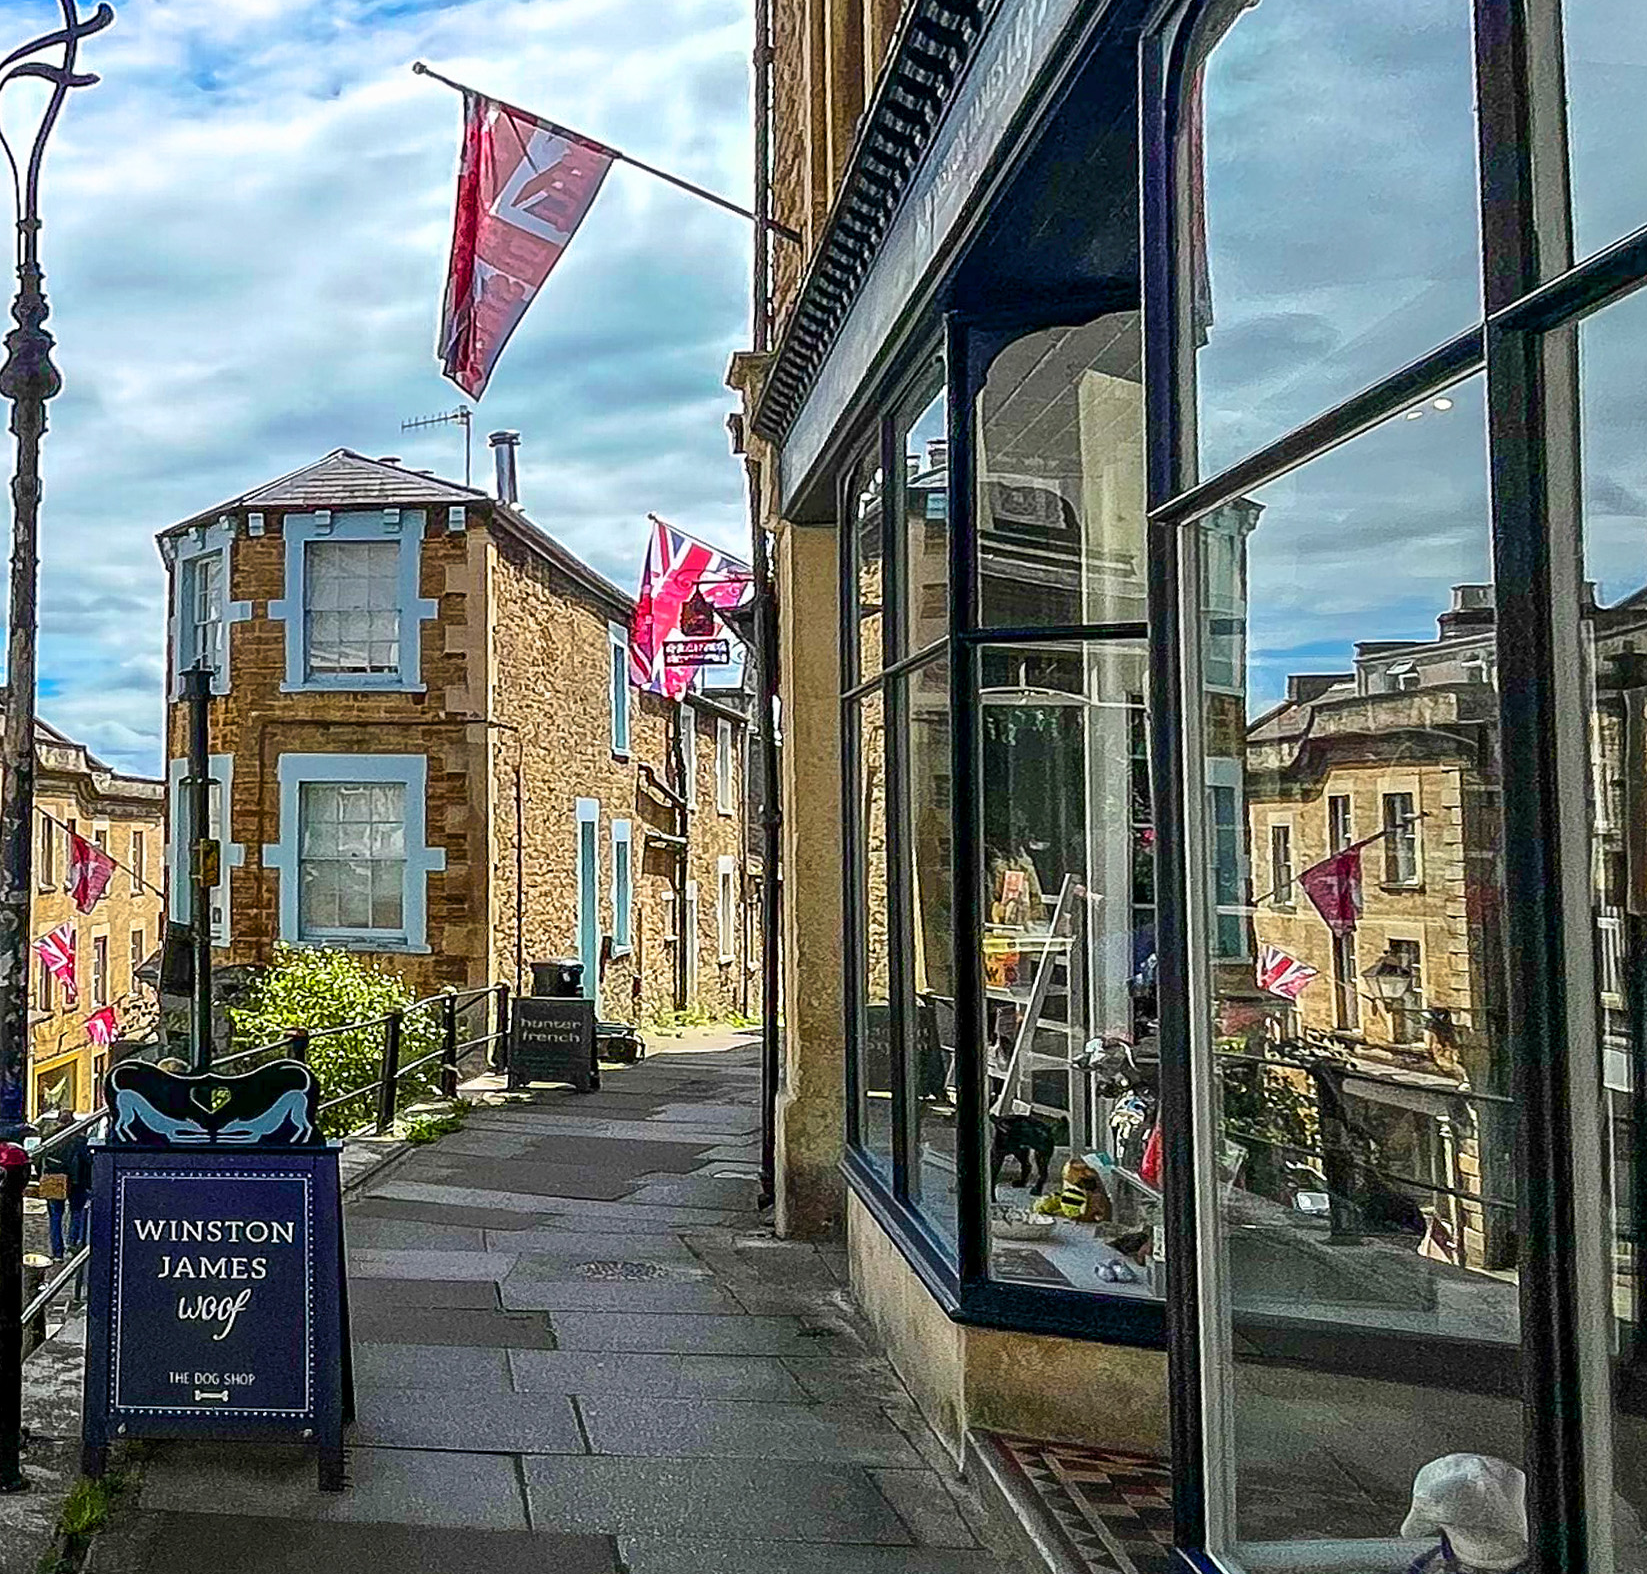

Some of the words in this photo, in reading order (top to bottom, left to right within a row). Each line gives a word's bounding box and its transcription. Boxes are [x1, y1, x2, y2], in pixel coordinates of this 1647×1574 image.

[520, 1017, 583, 1030] hunter
[521, 1031, 581, 1043] french
[134, 1219, 295, 1244] WINSTON
[157, 1256, 267, 1280] JAMES
[177, 1288, 252, 1341] woof
[168, 1371, 190, 1385] THE
[194, 1372, 221, 1386] DOG
[223, 1372, 256, 1387] SHOP
